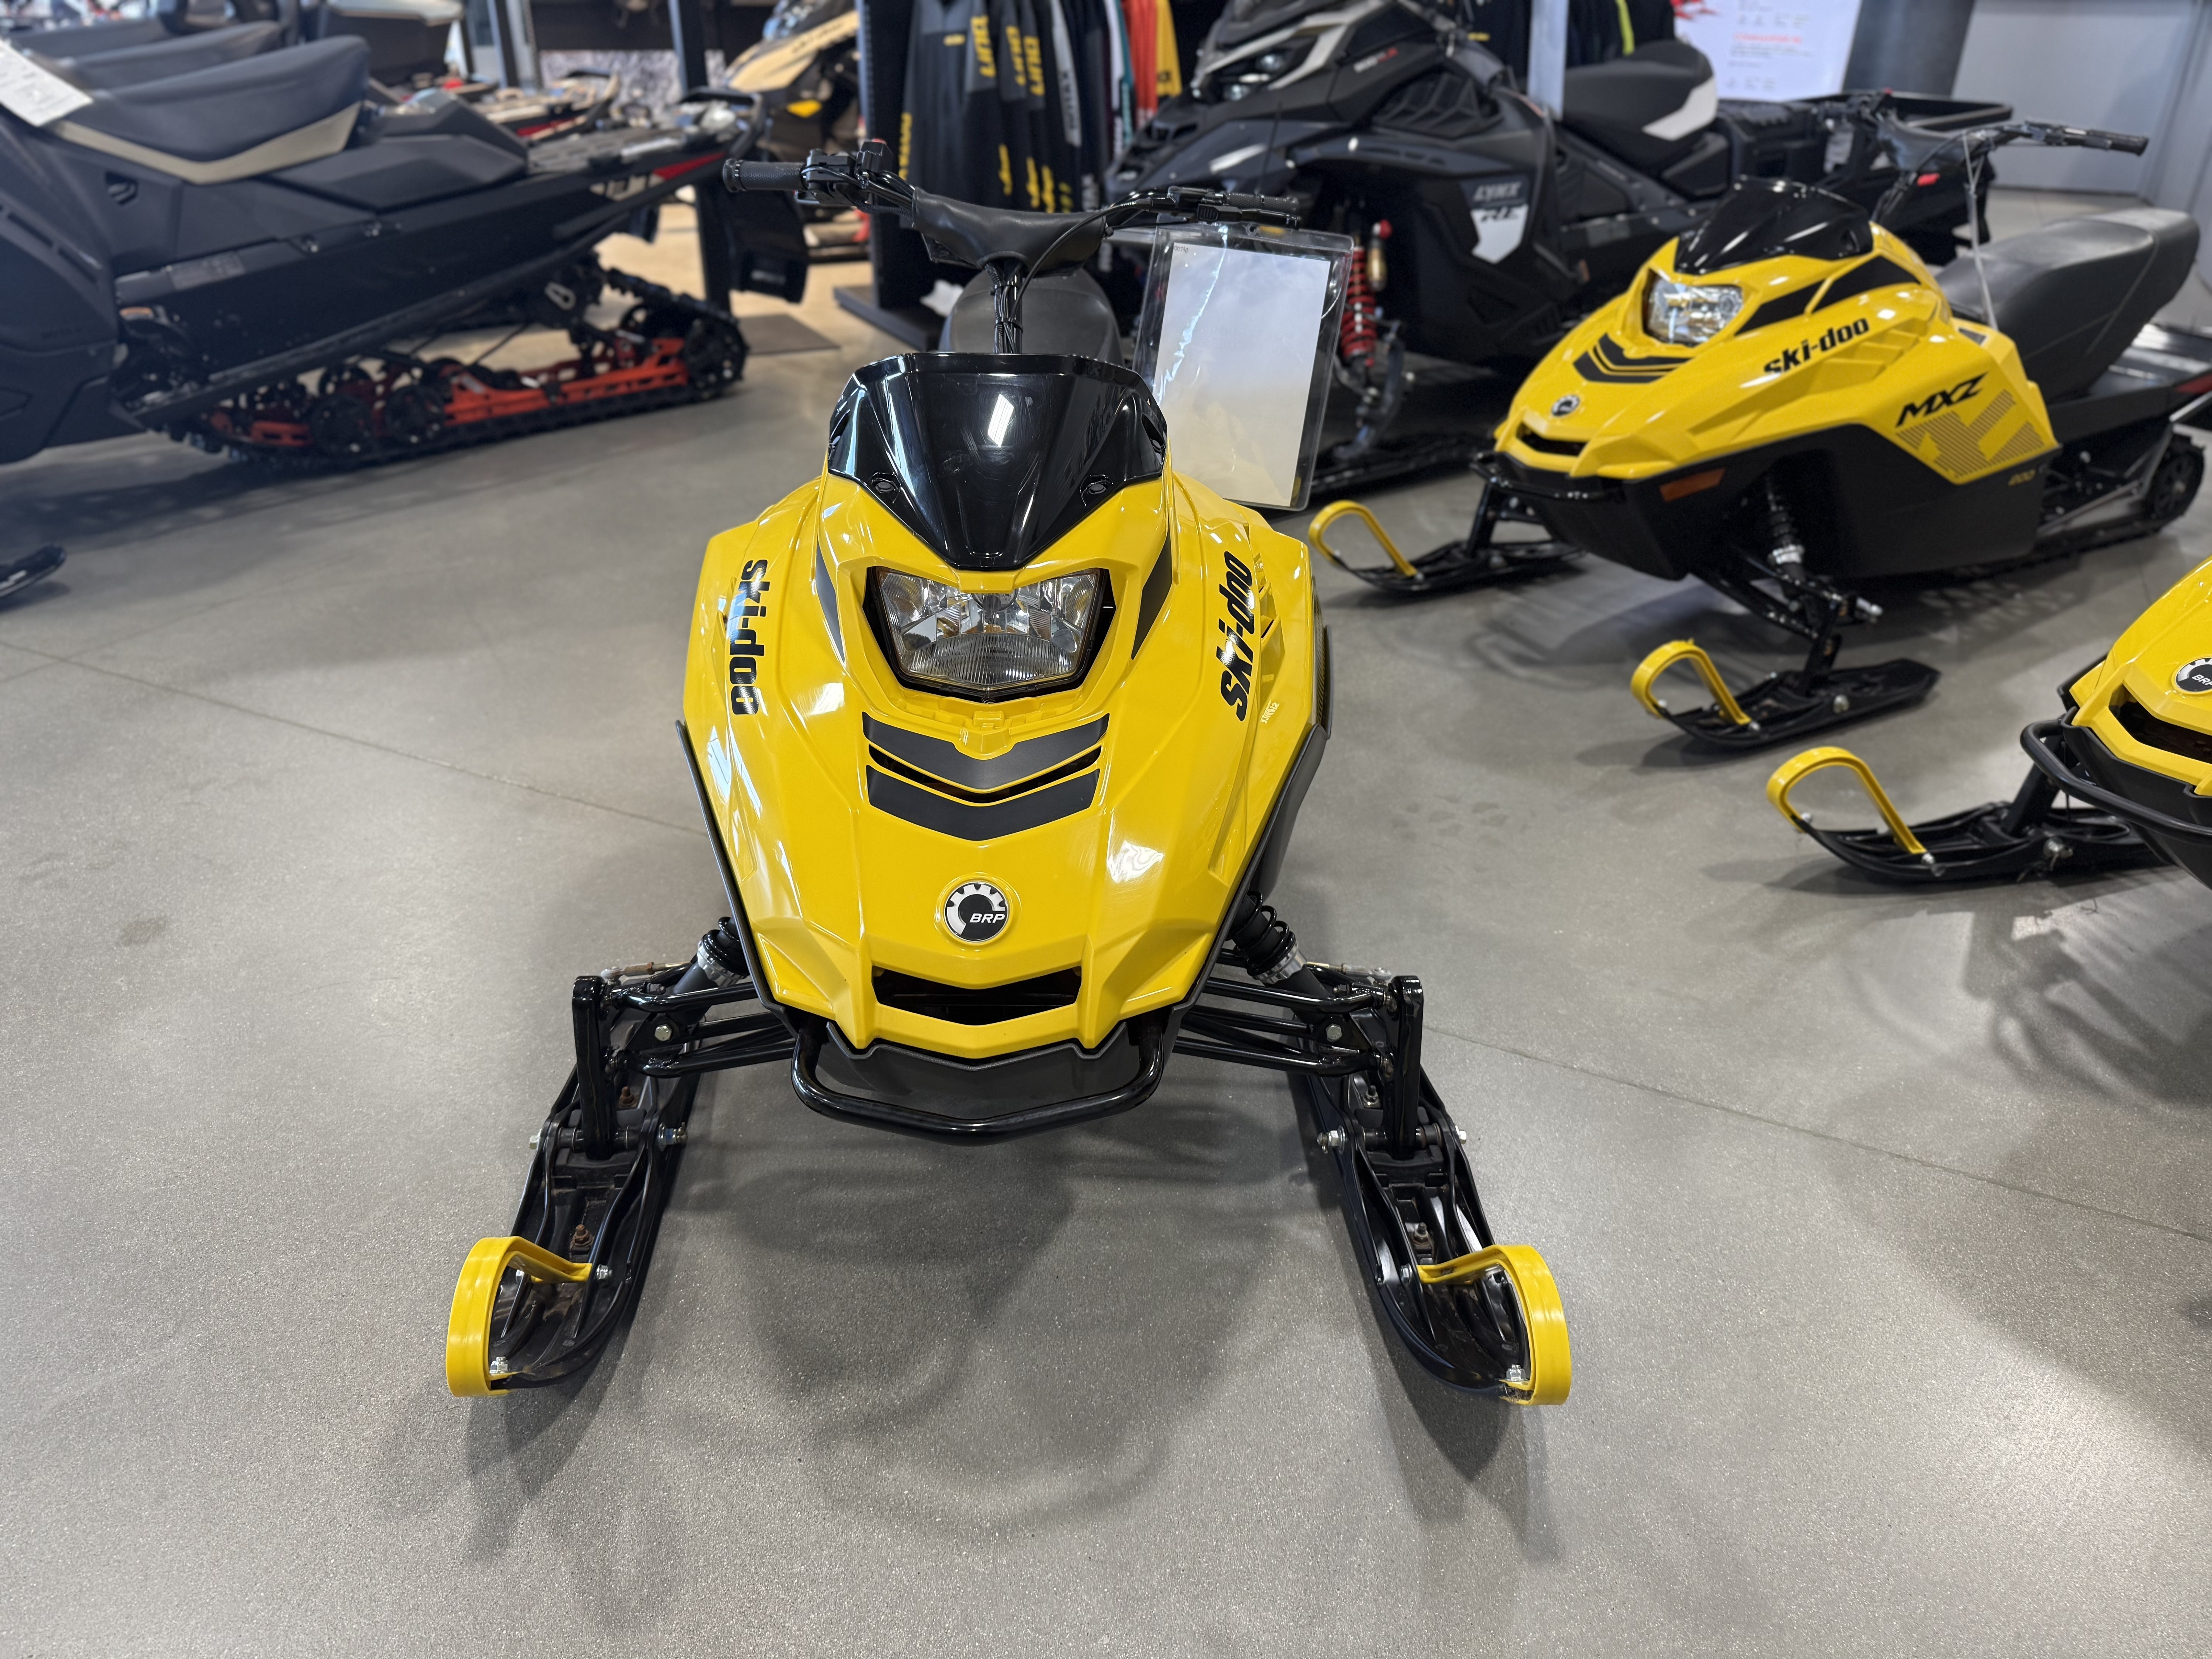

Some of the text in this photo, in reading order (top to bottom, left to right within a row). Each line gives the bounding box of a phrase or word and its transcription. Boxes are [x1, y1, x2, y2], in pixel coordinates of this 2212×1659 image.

[1764, 318, 1870, 373] ski-doo
[1896, 370, 1988, 428] MXZ
[730, 559, 770, 715] ski-doo
[1216, 551, 1255, 721] ski-doo
[969, 913, 1005, 923] BRP
